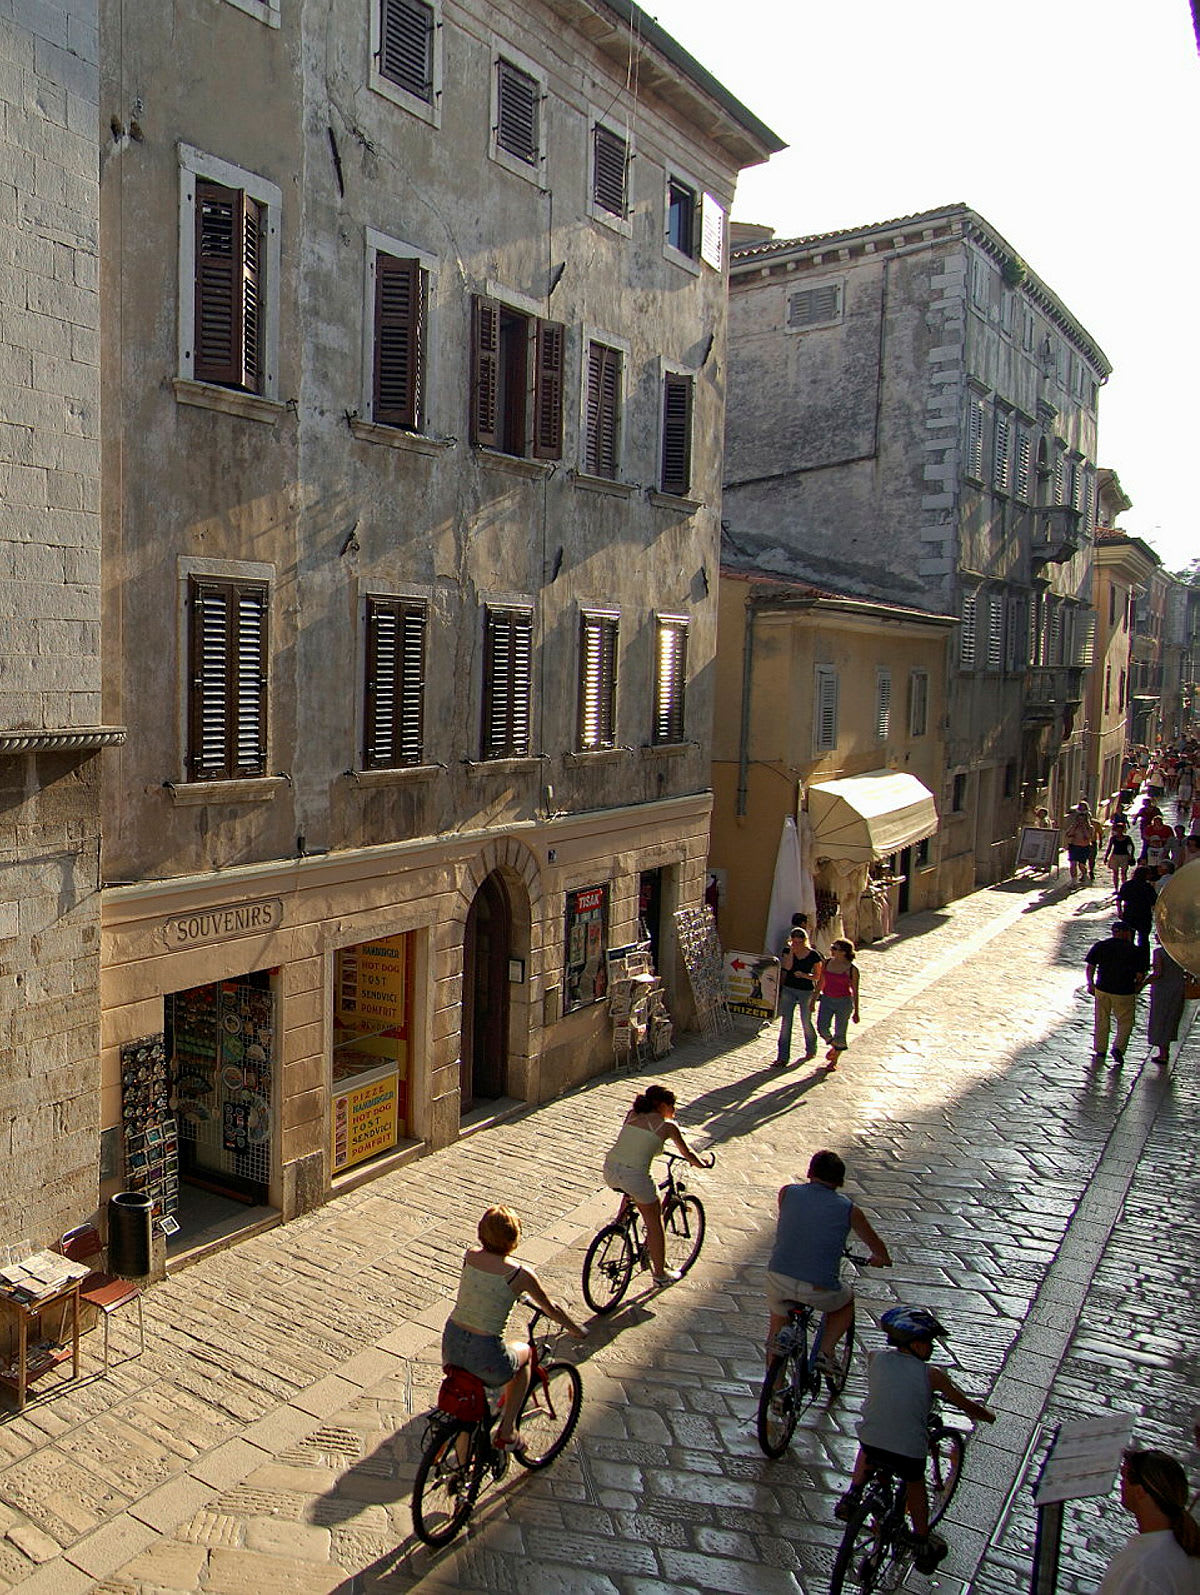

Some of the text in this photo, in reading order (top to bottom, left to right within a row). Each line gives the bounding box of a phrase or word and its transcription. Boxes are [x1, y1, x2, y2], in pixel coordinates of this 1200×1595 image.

[579, 893, 600, 909] TISAK
[177, 904, 273, 942] SOUVENIRS
[362, 961, 400, 973] HOT DOG
[361, 974, 387, 988] TOST
[353, 1086, 385, 1103] PIZZE
[352, 1102, 392, 1124] HOT DOG
[353, 1116, 381, 1134] TOST
[352, 1133, 391, 1157] POMFRIT
